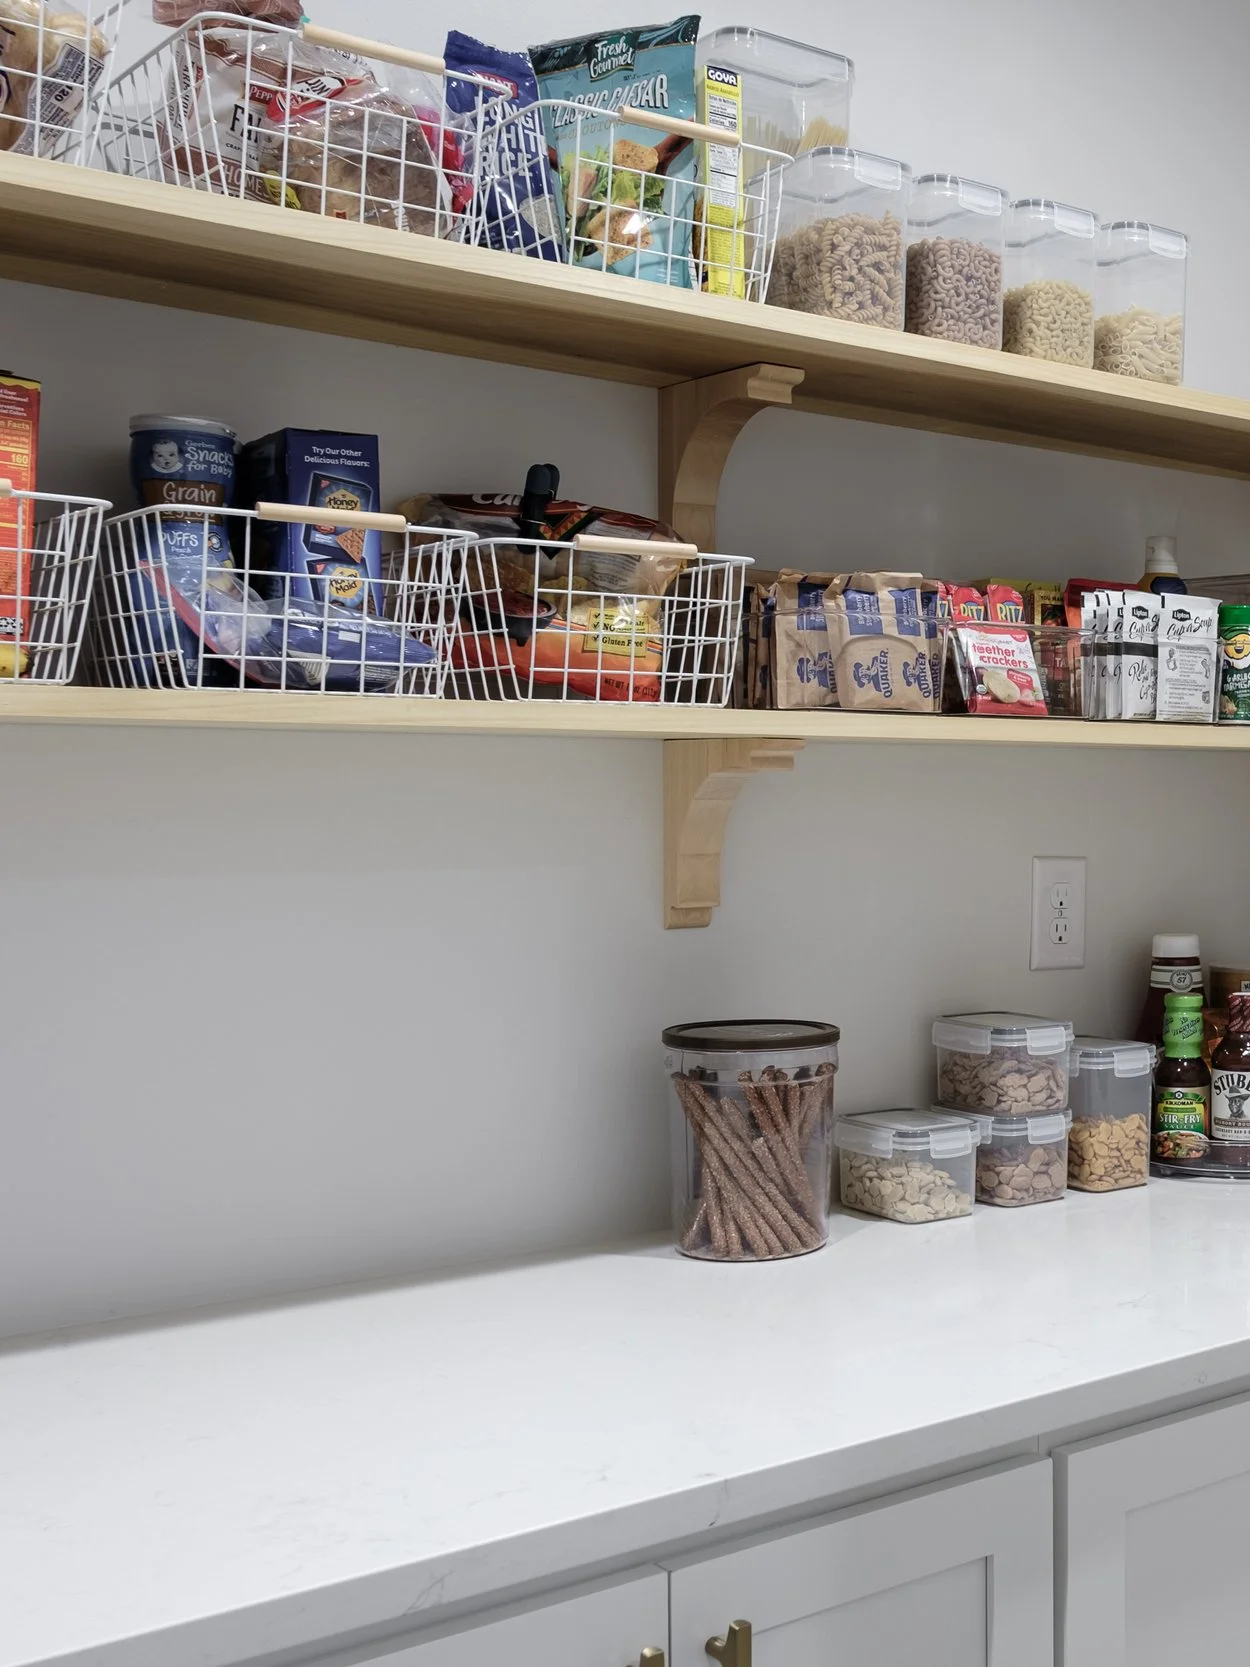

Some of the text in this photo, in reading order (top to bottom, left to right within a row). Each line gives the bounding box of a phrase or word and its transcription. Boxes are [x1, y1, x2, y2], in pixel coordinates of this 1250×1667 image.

[594, 36, 629, 60] Fresh
[589, 49, 635, 79] Gourmet
[708, 69, 737, 86] GOYA
[54, 84, 73, 102] 120
[609, 74, 669, 115] CAESAR
[479, 151, 534, 178] RICE
[184, 439, 217, 449] Gerber
[312, 446, 363, 457] Try Our Other
[11, 453, 30, 465] 160
[184, 447, 235, 467] Snacks
[304, 455, 370, 468] Delicious Flavors:
[187, 460, 233, 479] for Baby
[162, 481, 217, 504] Grain
[327, 495, 359, 508] Honey
[161, 530, 199, 547] PUFFS
[335, 581, 358, 595] Maid
[960, 603, 985, 622] RITZ
[996, 602, 1024, 623] RITZ
[1132, 609, 1149, 619] Lipton
[1173, 610, 1190, 620] Lipton
[602, 635, 626, 647] Gluten
[972, 643, 1016, 657] teether
[979, 655, 1029, 669] crackers
[878, 650, 893, 698] QUAKER
[919, 651, 932, 698] QUAKER
[1159, 1113, 1201, 1124] STIR-FRY
